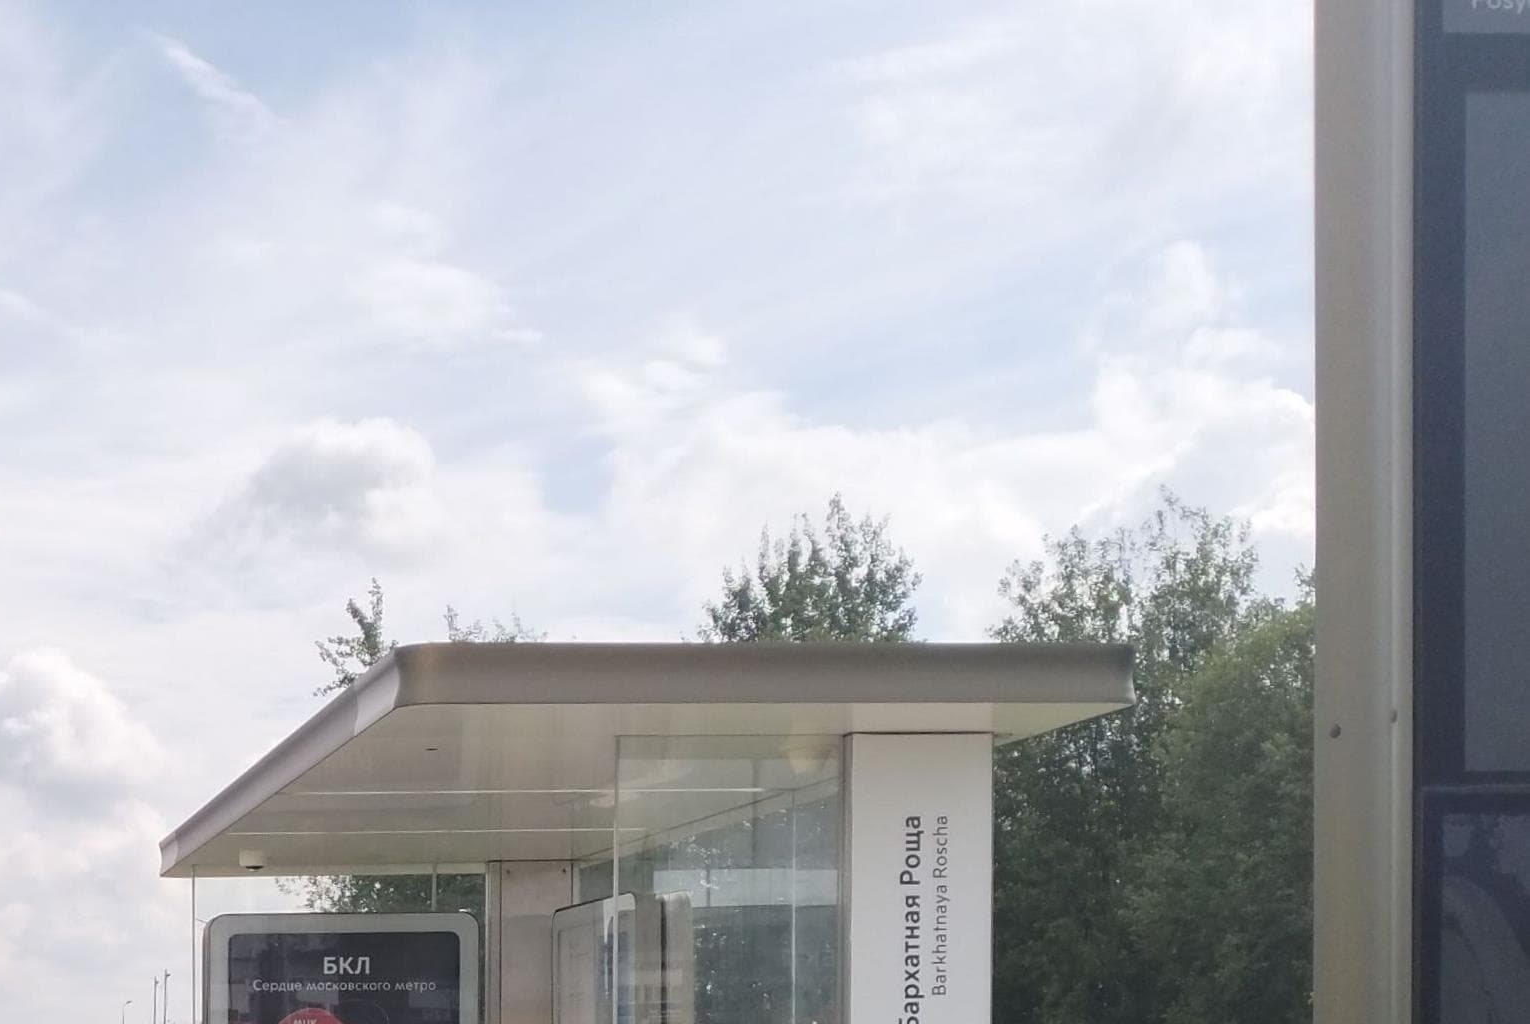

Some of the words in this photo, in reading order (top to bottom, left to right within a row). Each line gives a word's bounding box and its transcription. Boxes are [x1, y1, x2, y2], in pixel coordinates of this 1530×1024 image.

[900, 815, 924, 885] Роща
[933, 815, 948, 878] Roscha
[323, 956, 370, 975] БКЛ
[931, 884, 950, 996] Barkhatnaya
[253, 979, 302, 993] Сердце
[306, 981, 391, 991] московского
[395, 981, 437, 993] метро
